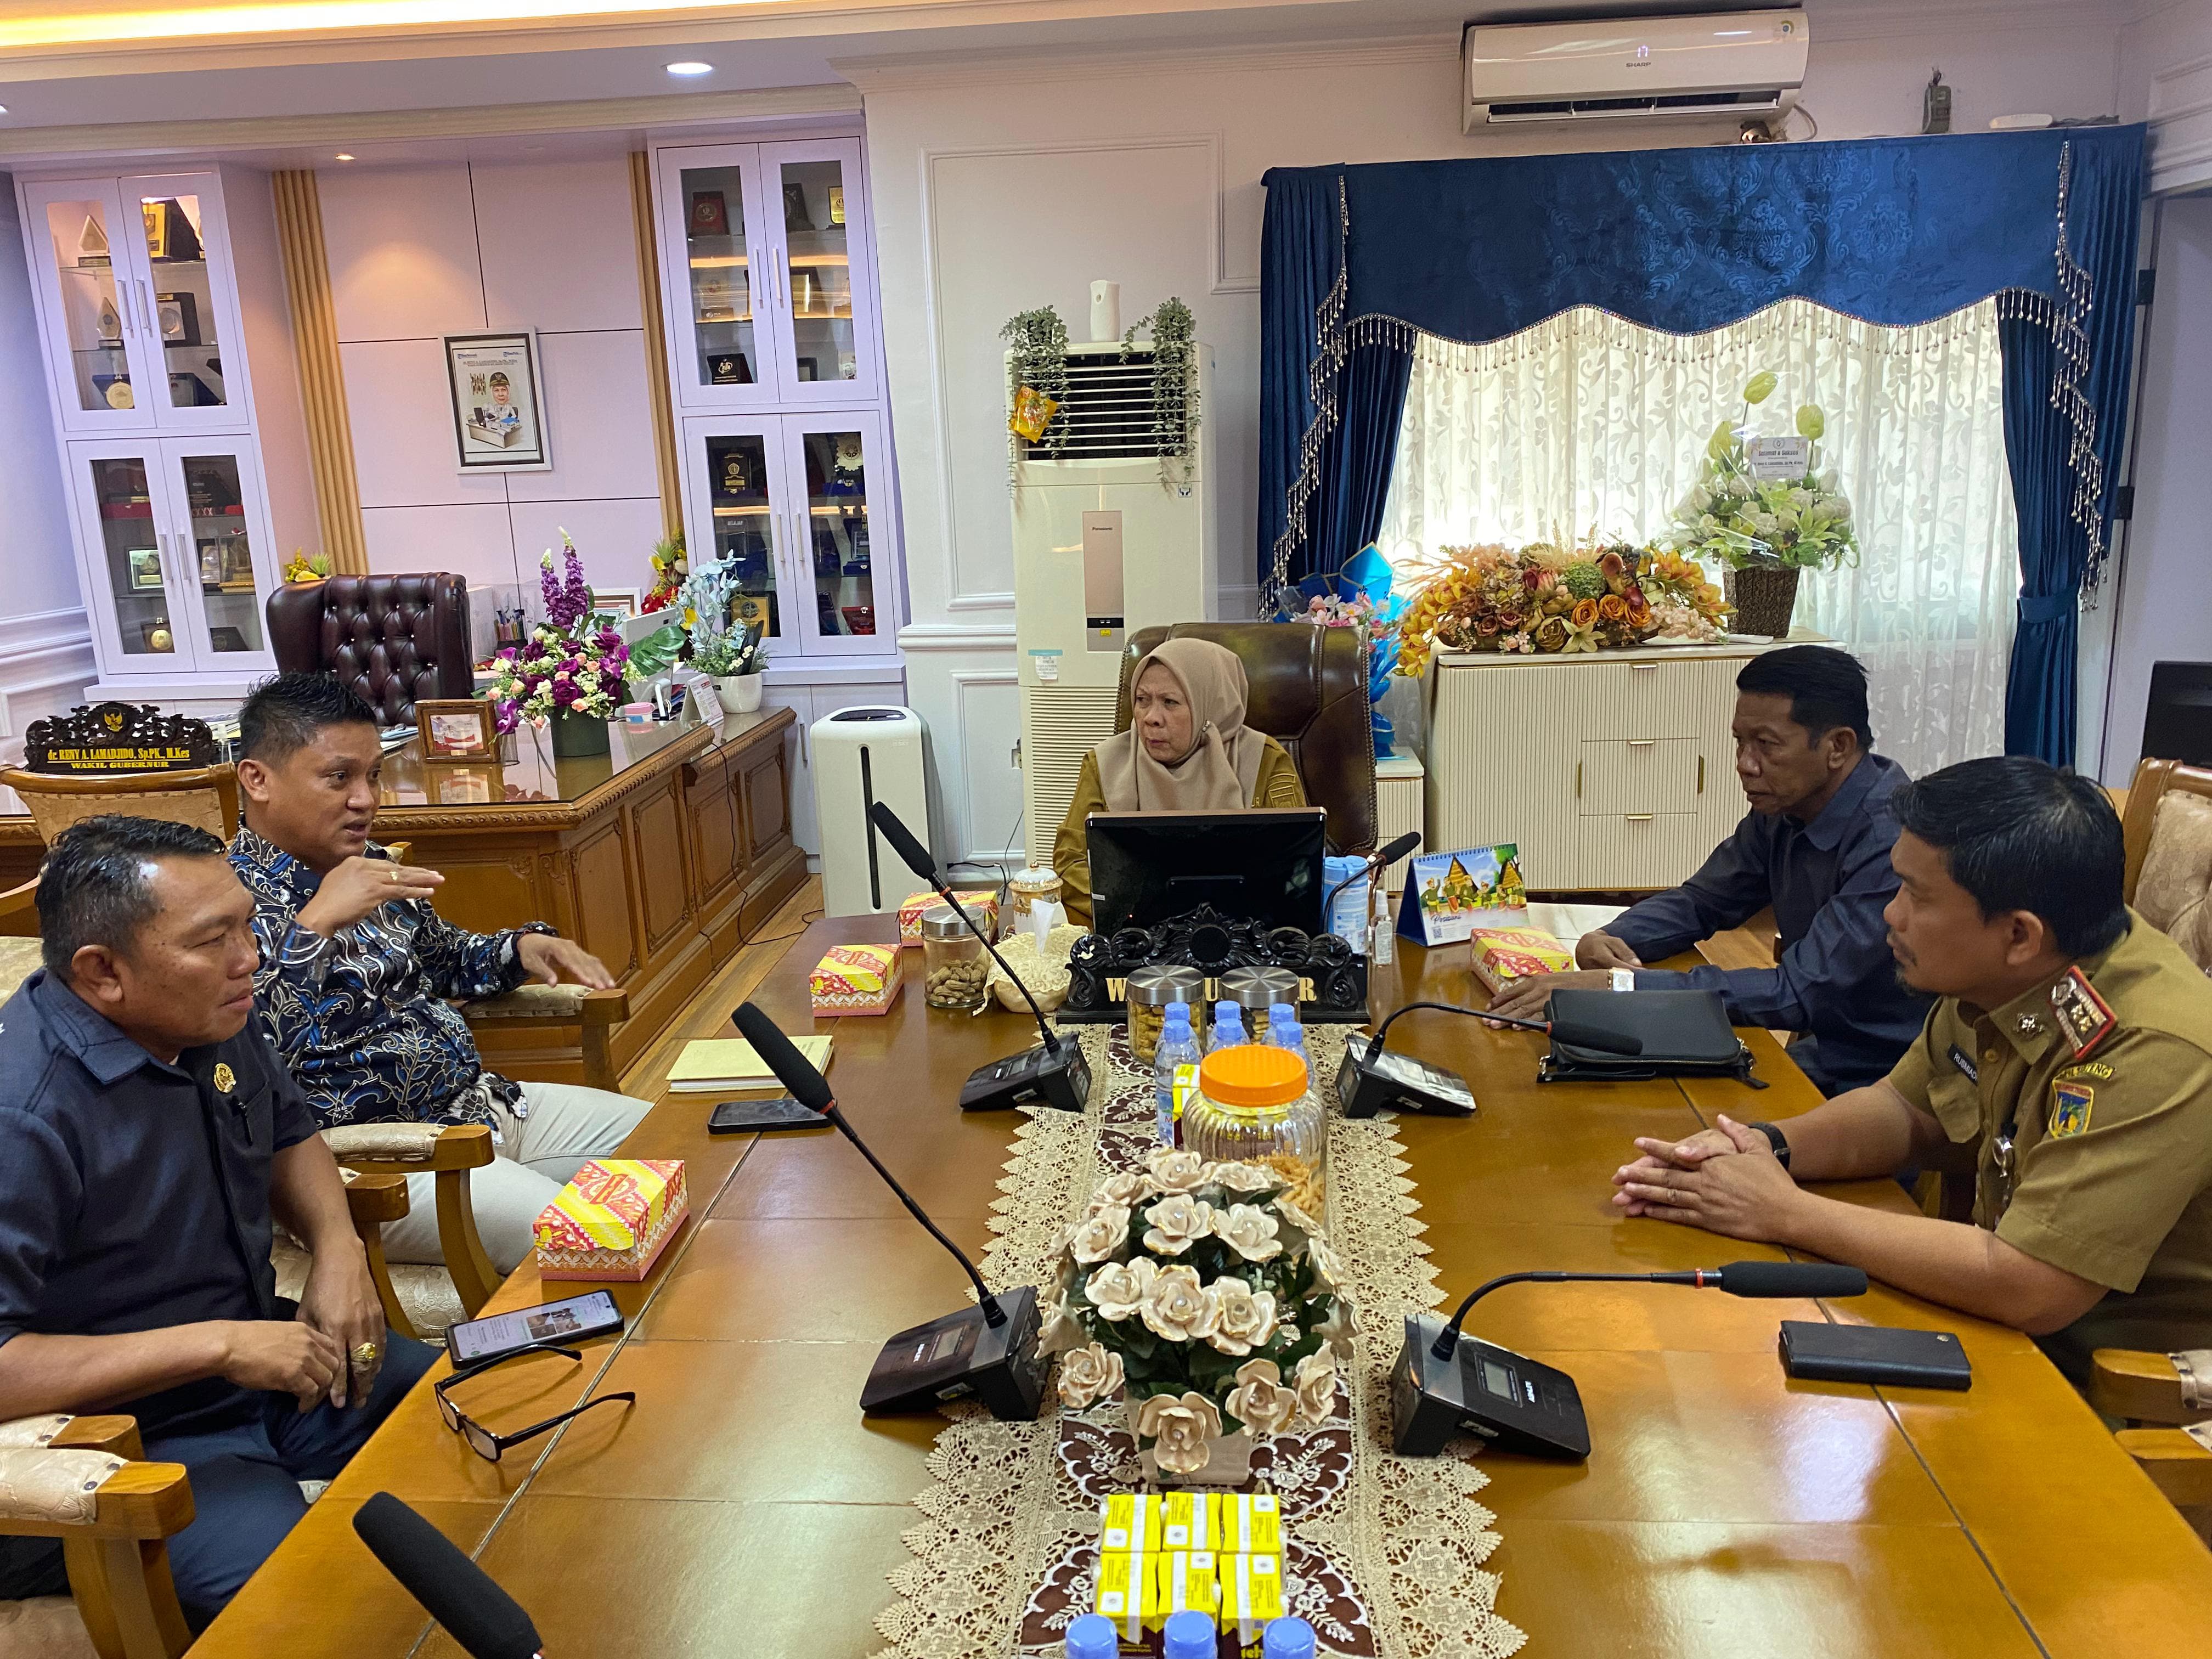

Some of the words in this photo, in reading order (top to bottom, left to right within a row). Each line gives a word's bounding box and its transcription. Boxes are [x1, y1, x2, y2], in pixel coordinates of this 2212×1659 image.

[59, 749, 80, 760] RENY
[81, 749, 89, 760] A.
[90, 748, 137, 760] LAMADJIDO,
[166, 747, 189, 759] M.Kes
